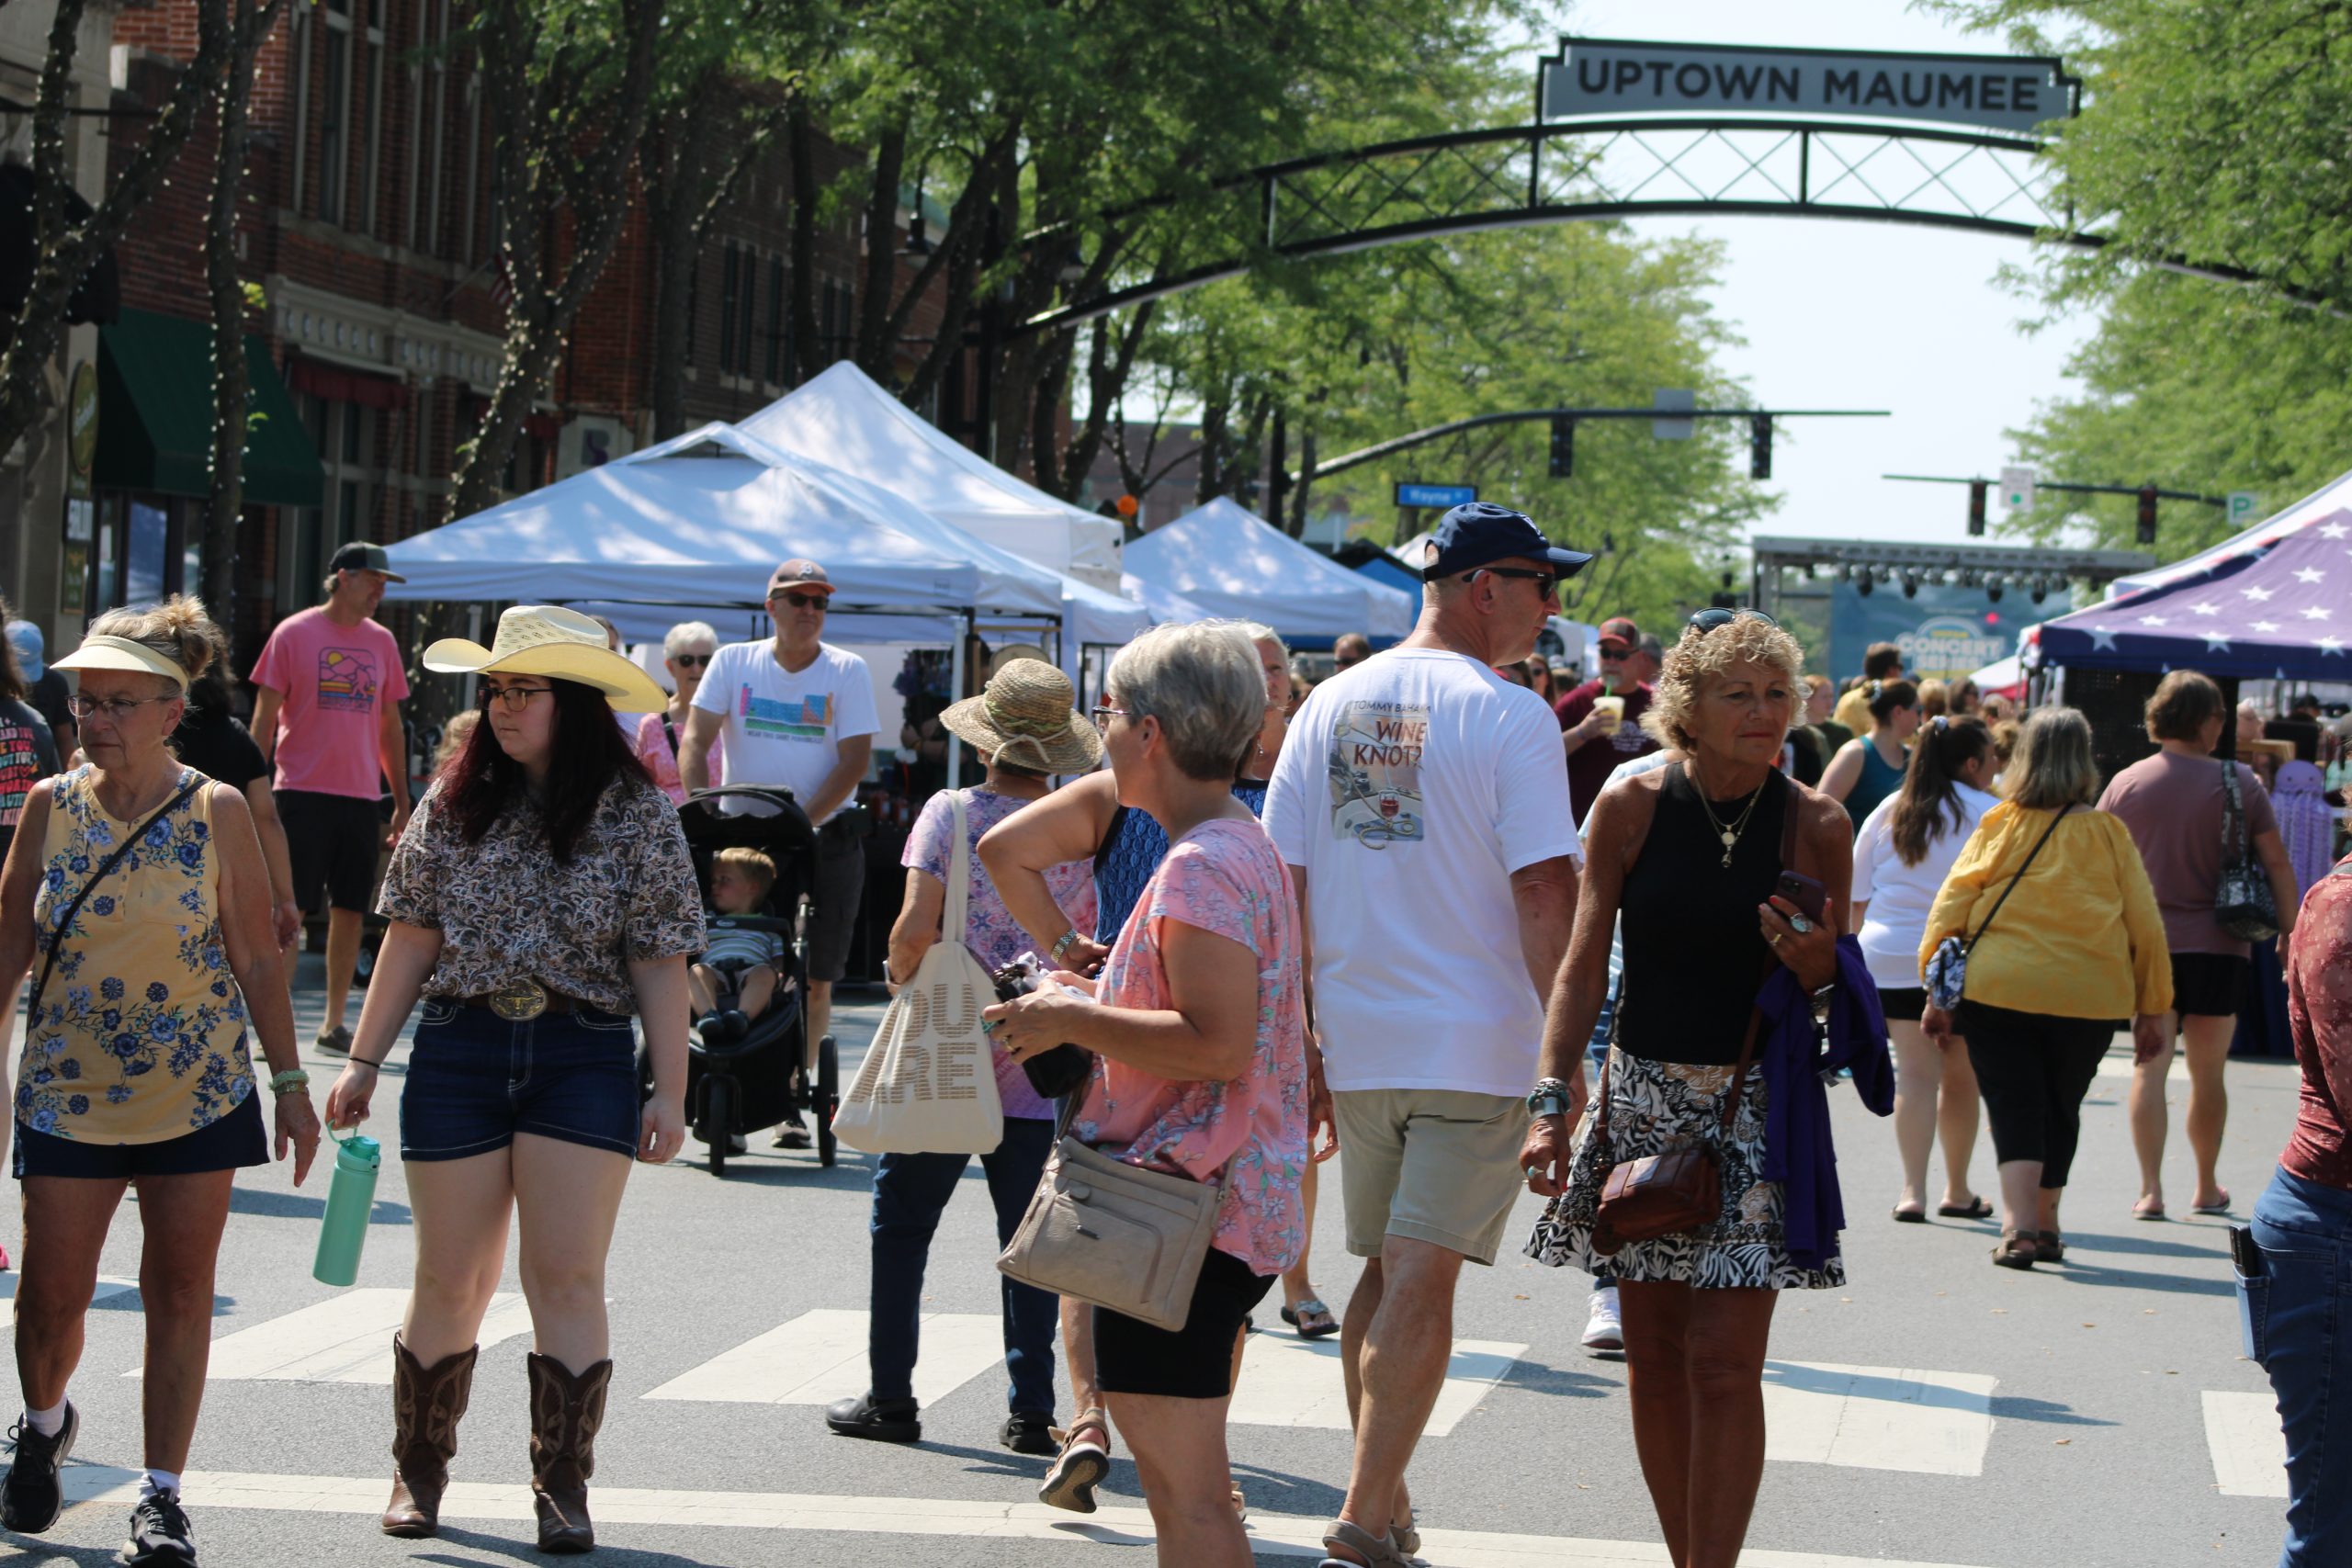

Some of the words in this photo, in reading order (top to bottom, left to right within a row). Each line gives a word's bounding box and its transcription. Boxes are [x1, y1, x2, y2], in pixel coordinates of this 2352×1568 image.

[1577, 59, 1799, 104] UPTOWN
[1823, 69, 2040, 112] MAUMEE
[1897, 636, 2001, 657] CONCERT
[1354, 700, 1393, 712] TOMMY
[1376, 720, 1427, 742] WINE
[1353, 744, 1422, 767] KNOT?
